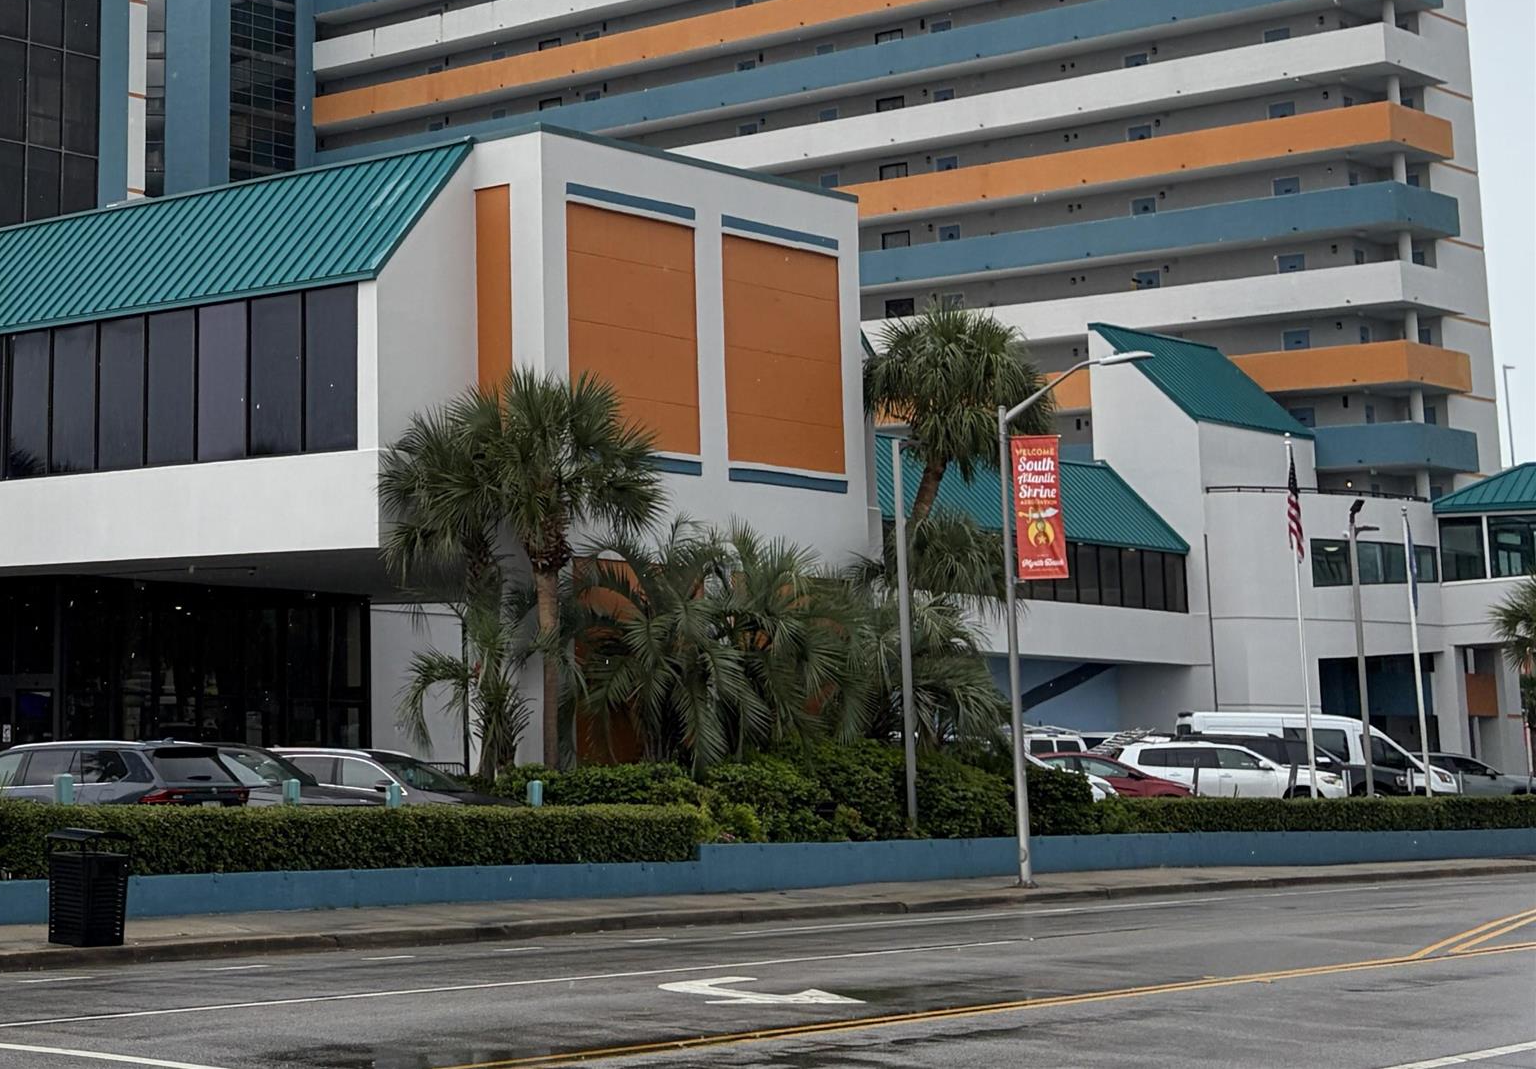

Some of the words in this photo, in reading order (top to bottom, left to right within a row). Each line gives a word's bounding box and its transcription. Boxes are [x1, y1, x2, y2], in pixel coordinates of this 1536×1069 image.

[1015, 447, 1055, 456] WELCOME
[1018, 457, 1055, 472] South
[1017, 472, 1055, 484] Atlantic
[1019, 484, 1056, 499] Shrine
